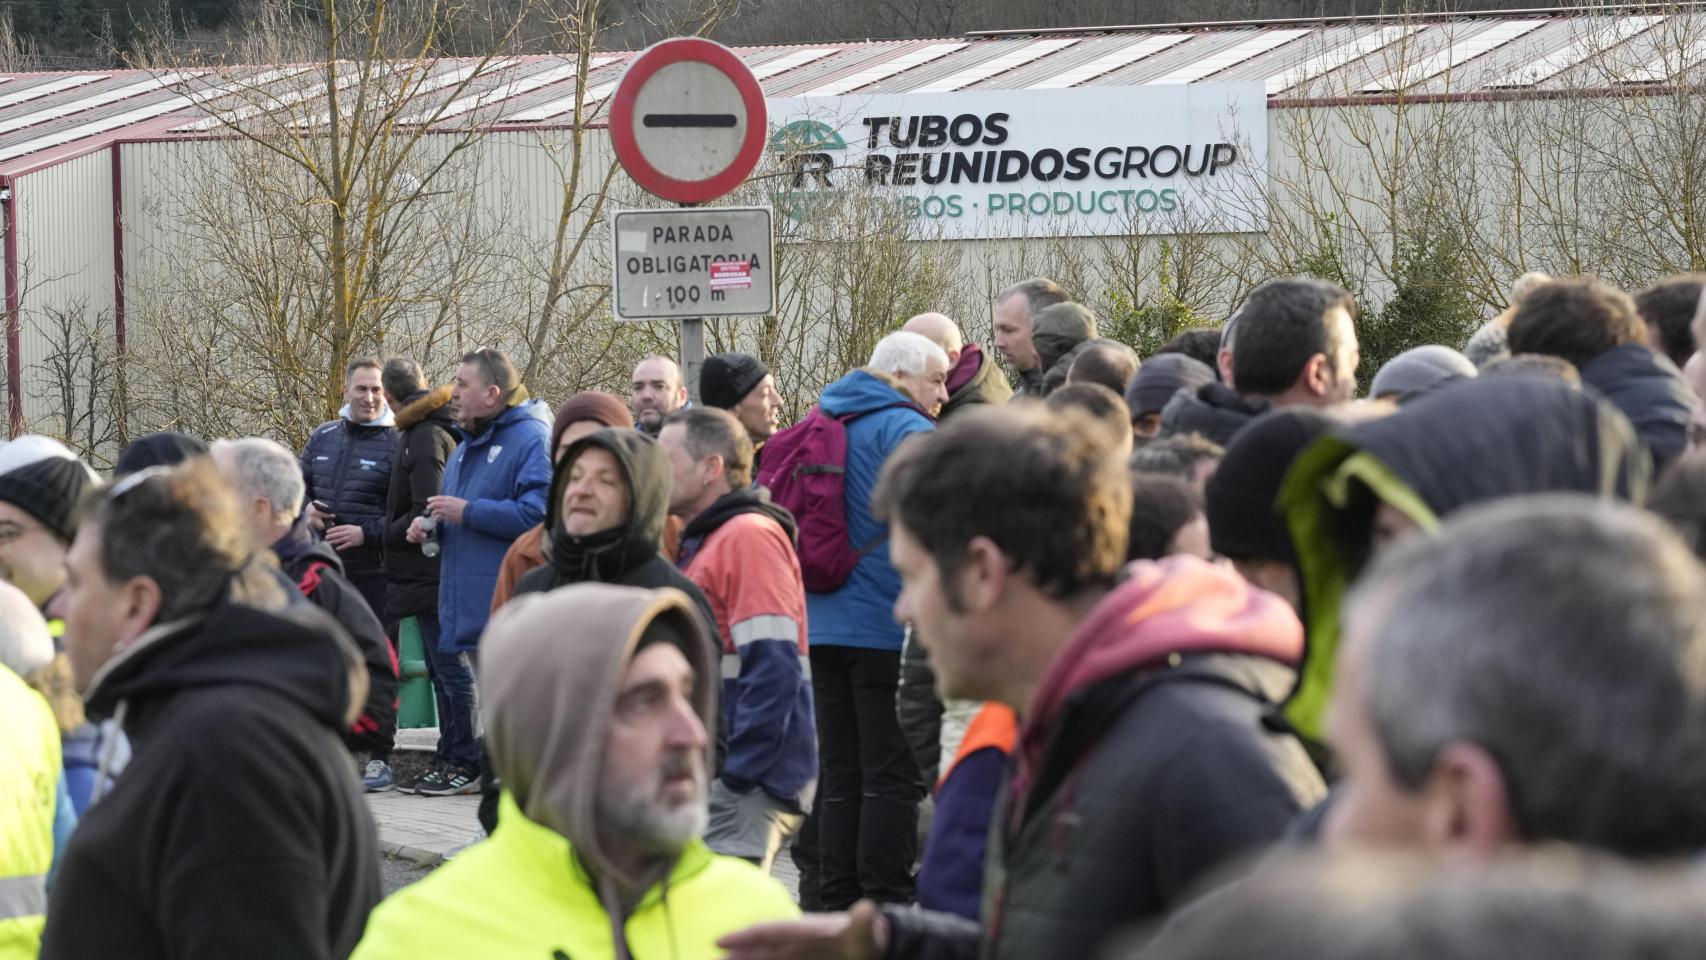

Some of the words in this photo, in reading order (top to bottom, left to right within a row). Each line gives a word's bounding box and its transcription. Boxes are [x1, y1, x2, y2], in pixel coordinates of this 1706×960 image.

[863, 112, 1009, 148] TUBOS
[987, 188, 1178, 216] PRODUCTOS
[653, 225, 733, 243] PARADA
[666, 285, 700, 303] 100
[711, 289, 725, 301] m
